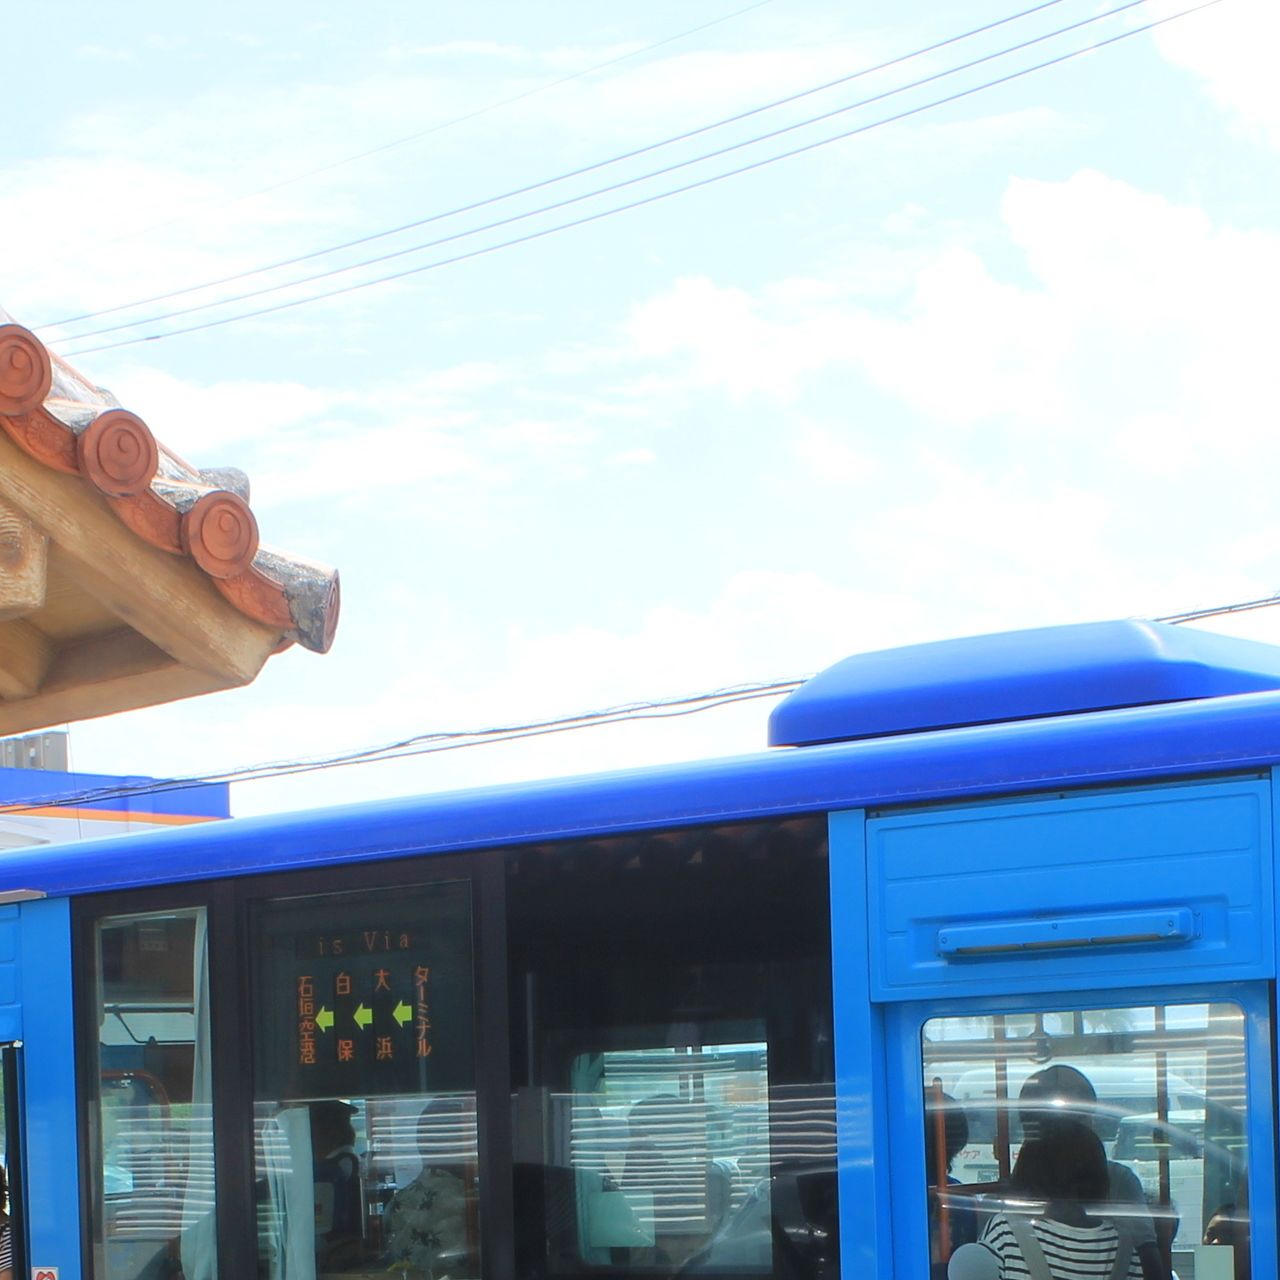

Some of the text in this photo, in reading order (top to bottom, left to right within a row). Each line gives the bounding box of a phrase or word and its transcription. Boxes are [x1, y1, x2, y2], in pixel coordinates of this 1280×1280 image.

[362, 930, 409, 951] Via
[298, 976, 316, 1064] 石垣空港
[415, 965, 432, 1057] ターミナル
